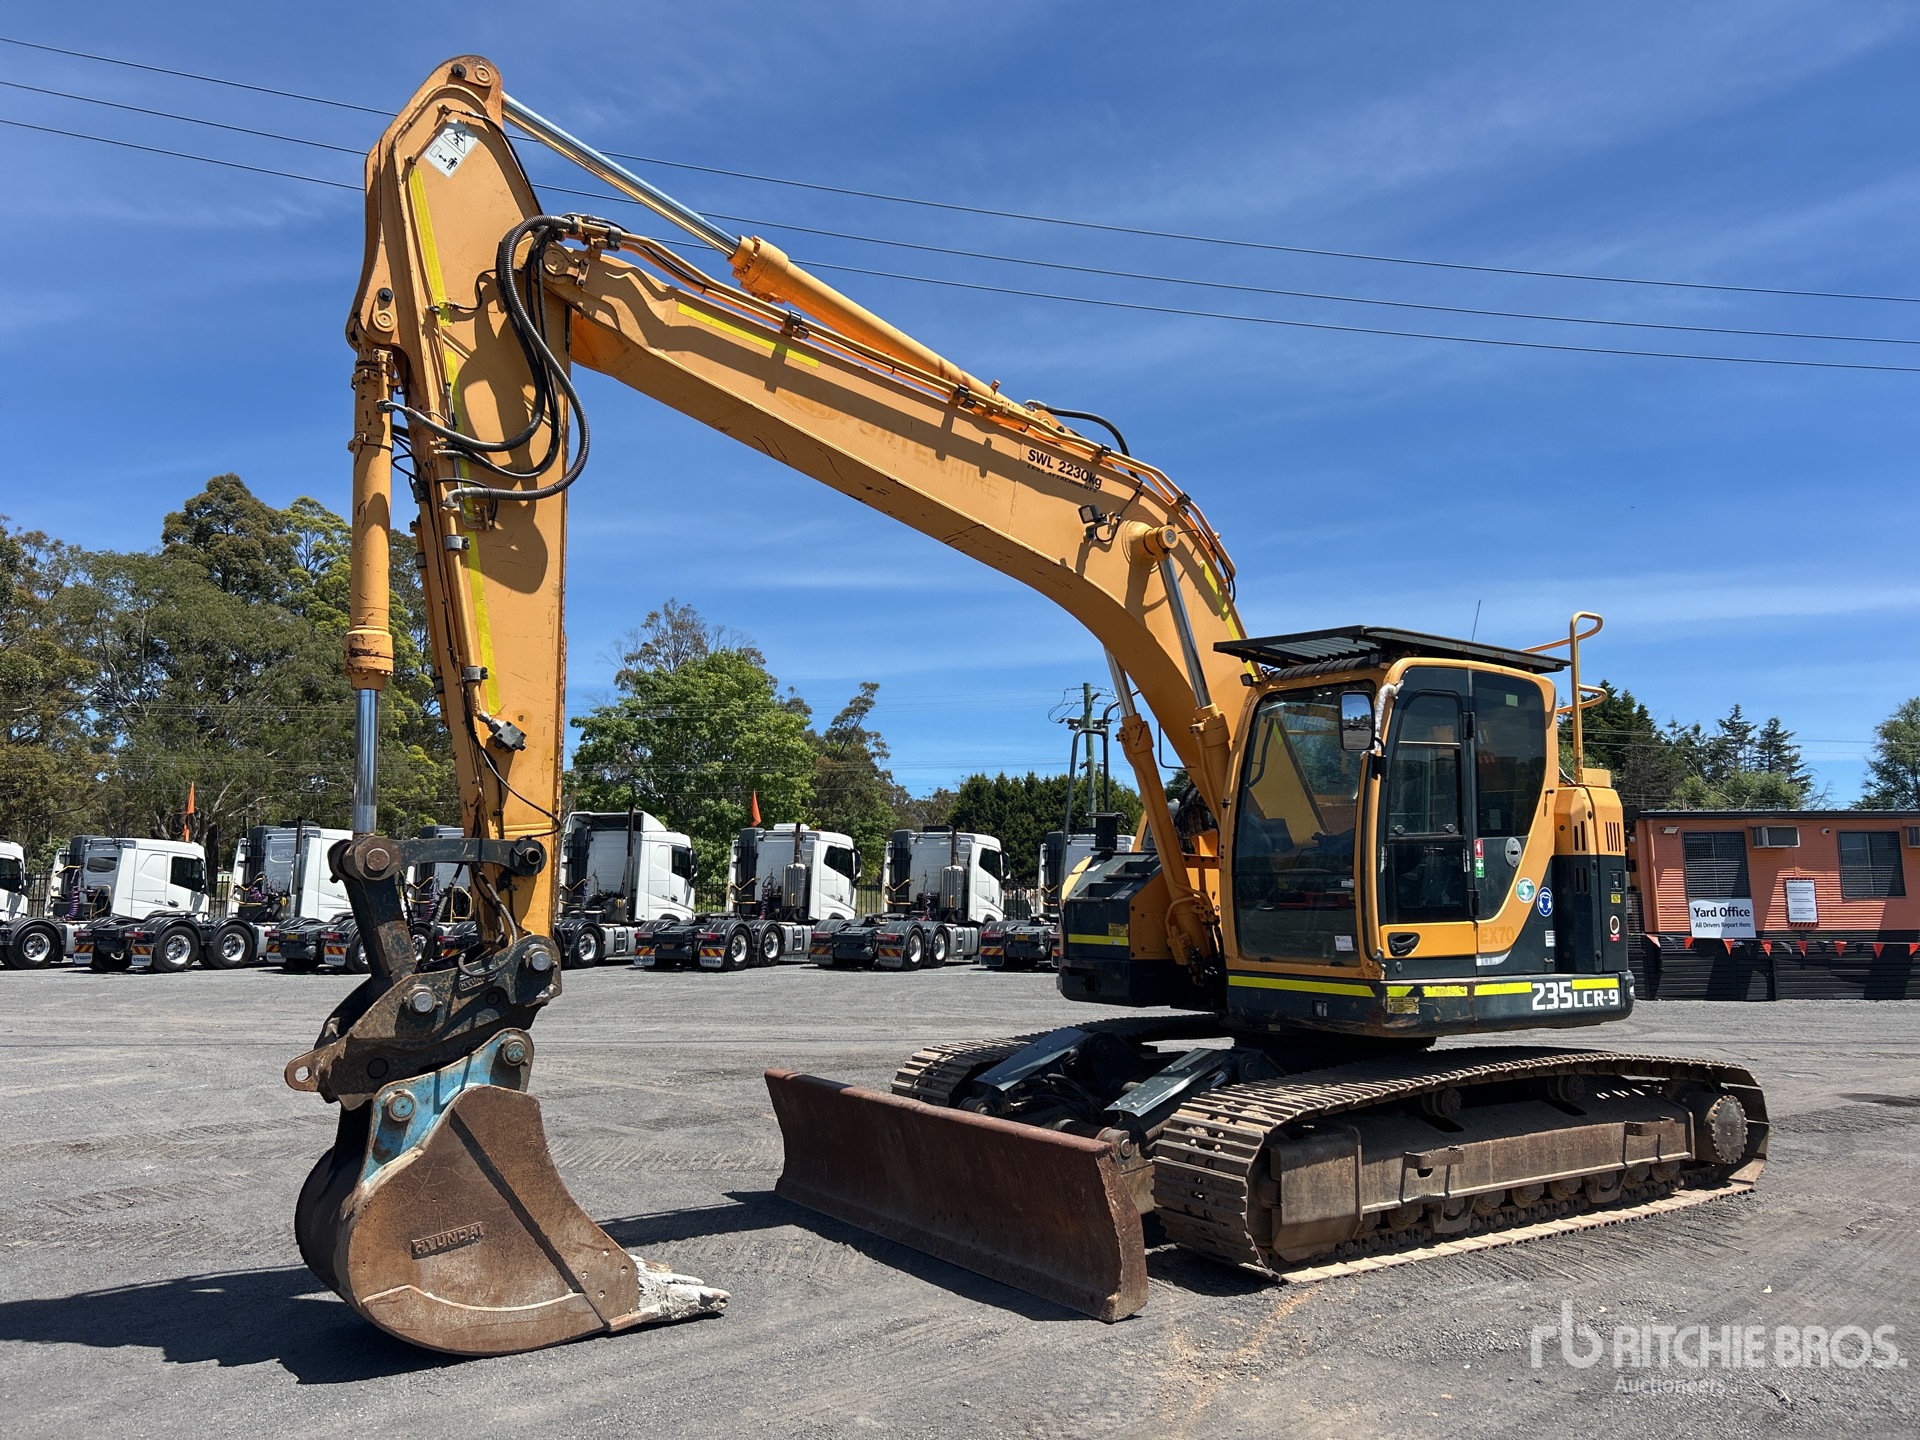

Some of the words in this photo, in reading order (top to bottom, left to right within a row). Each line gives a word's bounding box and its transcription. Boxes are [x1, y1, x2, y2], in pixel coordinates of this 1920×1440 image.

[1027, 464, 1045, 474] LESS
[1047, 472, 1097, 493] ATTACHMENTS
[1028, 449, 1053, 469] SWL
[1058, 461, 1102, 490] 2230kg
[1693, 906, 1717, 917] Yard
[1719, 906, 1751, 917] Office
[1480, 926, 1515, 944] EX70
[1532, 982, 1619, 1010] 235LCR-9
